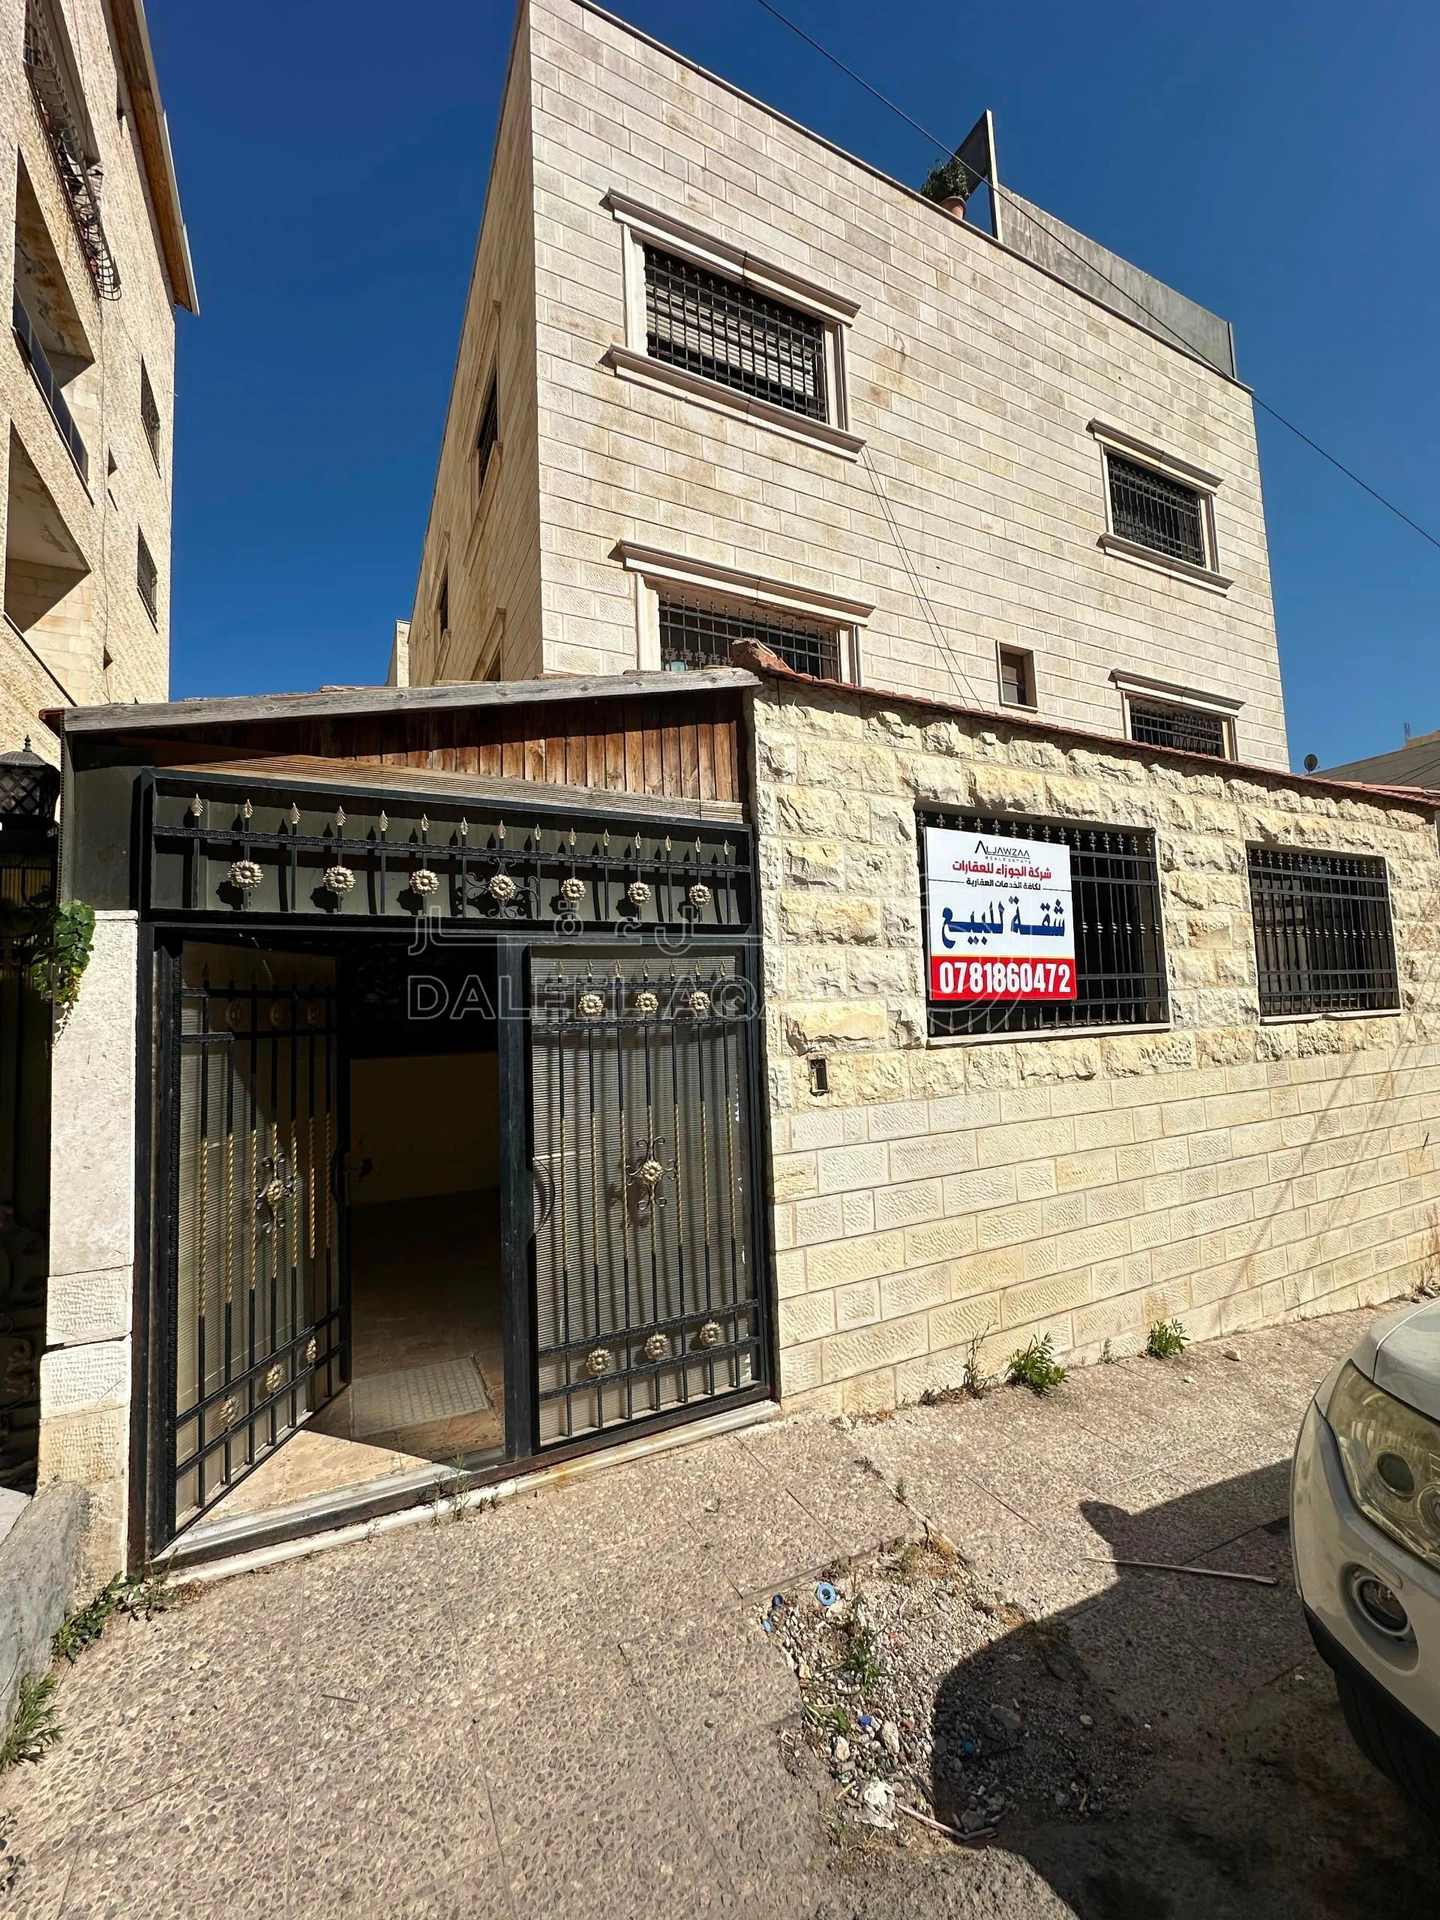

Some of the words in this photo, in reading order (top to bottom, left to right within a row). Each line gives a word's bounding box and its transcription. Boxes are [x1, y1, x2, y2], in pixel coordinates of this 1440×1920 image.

[974, 840, 1031, 858] ALJAWZAA
[952, 860, 994, 875] للعقارات
[995, 863, 1027, 879] الجوزاء
[1028, 866, 1052, 881] شركة
[966, 878, 995, 888] العقارية
[995, 880, 1022, 890] الخدمات
[1022, 881, 1041, 891] لكافة
[1008, 895, 1065, 937] شقة
[941, 900, 1005, 949] للبيع
[938, 961, 1071, 994] 0781860472
